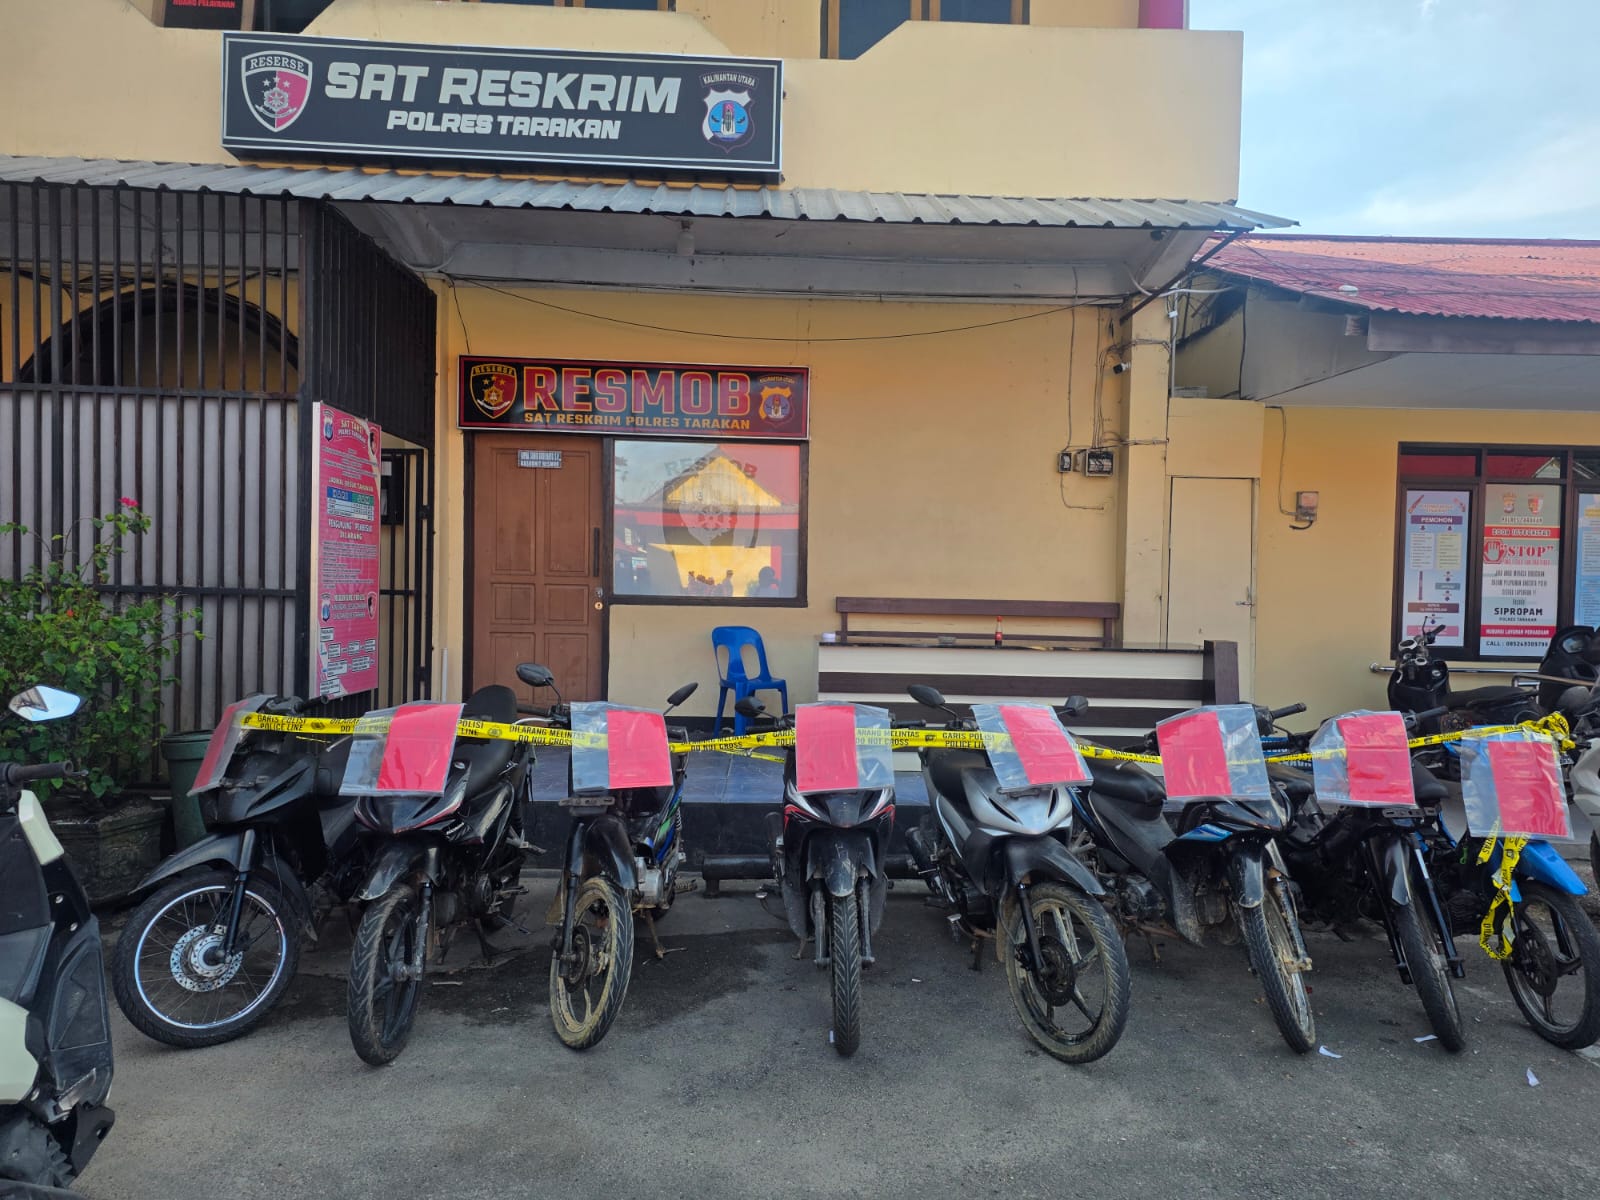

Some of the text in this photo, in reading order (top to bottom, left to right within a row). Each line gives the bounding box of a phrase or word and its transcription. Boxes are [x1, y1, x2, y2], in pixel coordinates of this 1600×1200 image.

[250, 56, 304, 72] RESERSE
[324, 62, 682, 114] SAT RESKRIM
[703, 73, 755, 87] KALIMANTAN UTARA
[387, 110, 621, 140] POLRES TARAKAN
[523, 367, 751, 416] RESMOB
[524, 412, 751, 430] SAT RESKRIM POLRES TARAKAN
[1494, 607, 1543, 616] SIPROPAM
[943, 731, 967, 740] GARIS
[945, 740, 971, 749] POLICE
